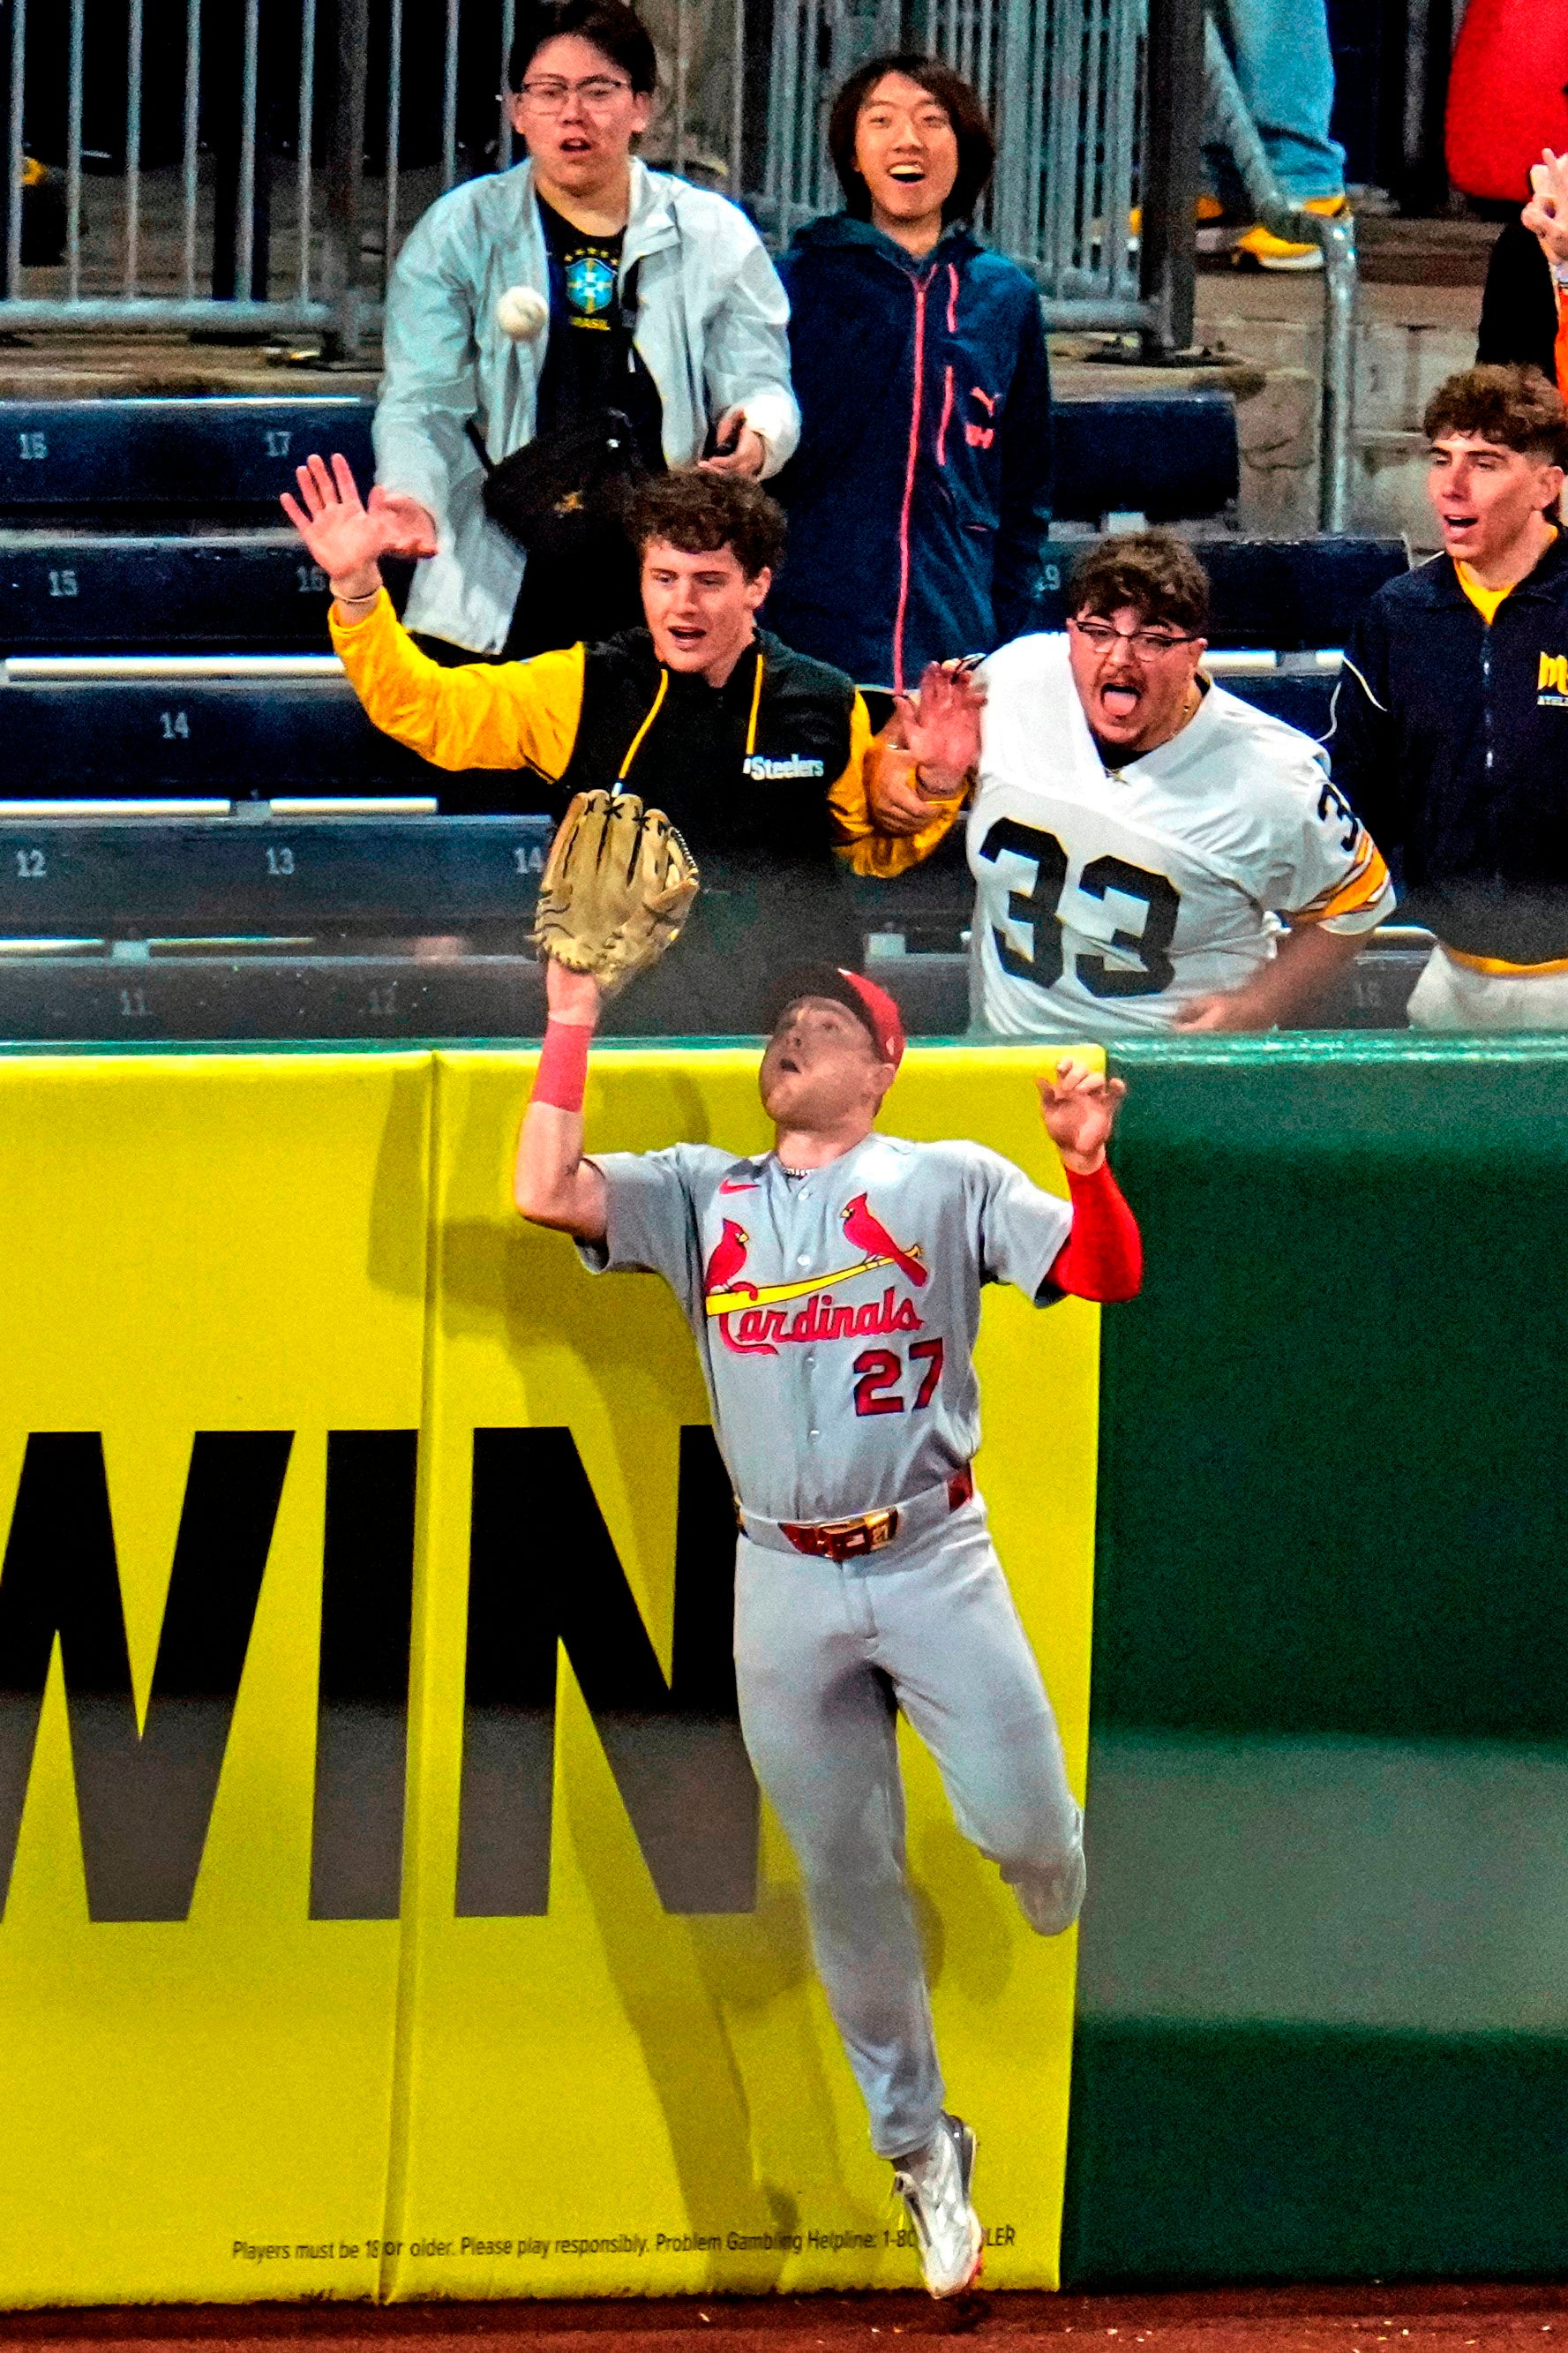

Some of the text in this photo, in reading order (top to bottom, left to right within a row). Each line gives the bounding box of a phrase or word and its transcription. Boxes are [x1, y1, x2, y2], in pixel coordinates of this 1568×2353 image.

[266, 431, 292, 457] 17
[49, 570, 78, 597] 15
[160, 712, 190, 739] 14
[750, 753, 824, 781] Steelers
[17, 849, 46, 877] 12
[266, 847, 295, 875] 13
[514, 847, 544, 874] 14
[979, 817, 1181, 998] 33
[718, 1282, 926, 1357] Cardinals
[852, 1336, 944, 1417] 27
[0, 1425, 765, 1924] WIN
[232, 2240, 291, 2265] Players
[295, 2244, 334, 2259] must
[339, 2242, 360, 2259] be
[385, 2241, 403, 2256] or
[461, 2236, 513, 2256] Please
[517, 2237, 550, 2259] play
[555, 2233, 649, 2257] responsibly.
[656, 2233, 722, 2252] Problem
[726, 2231, 803, 2254] Gambling
